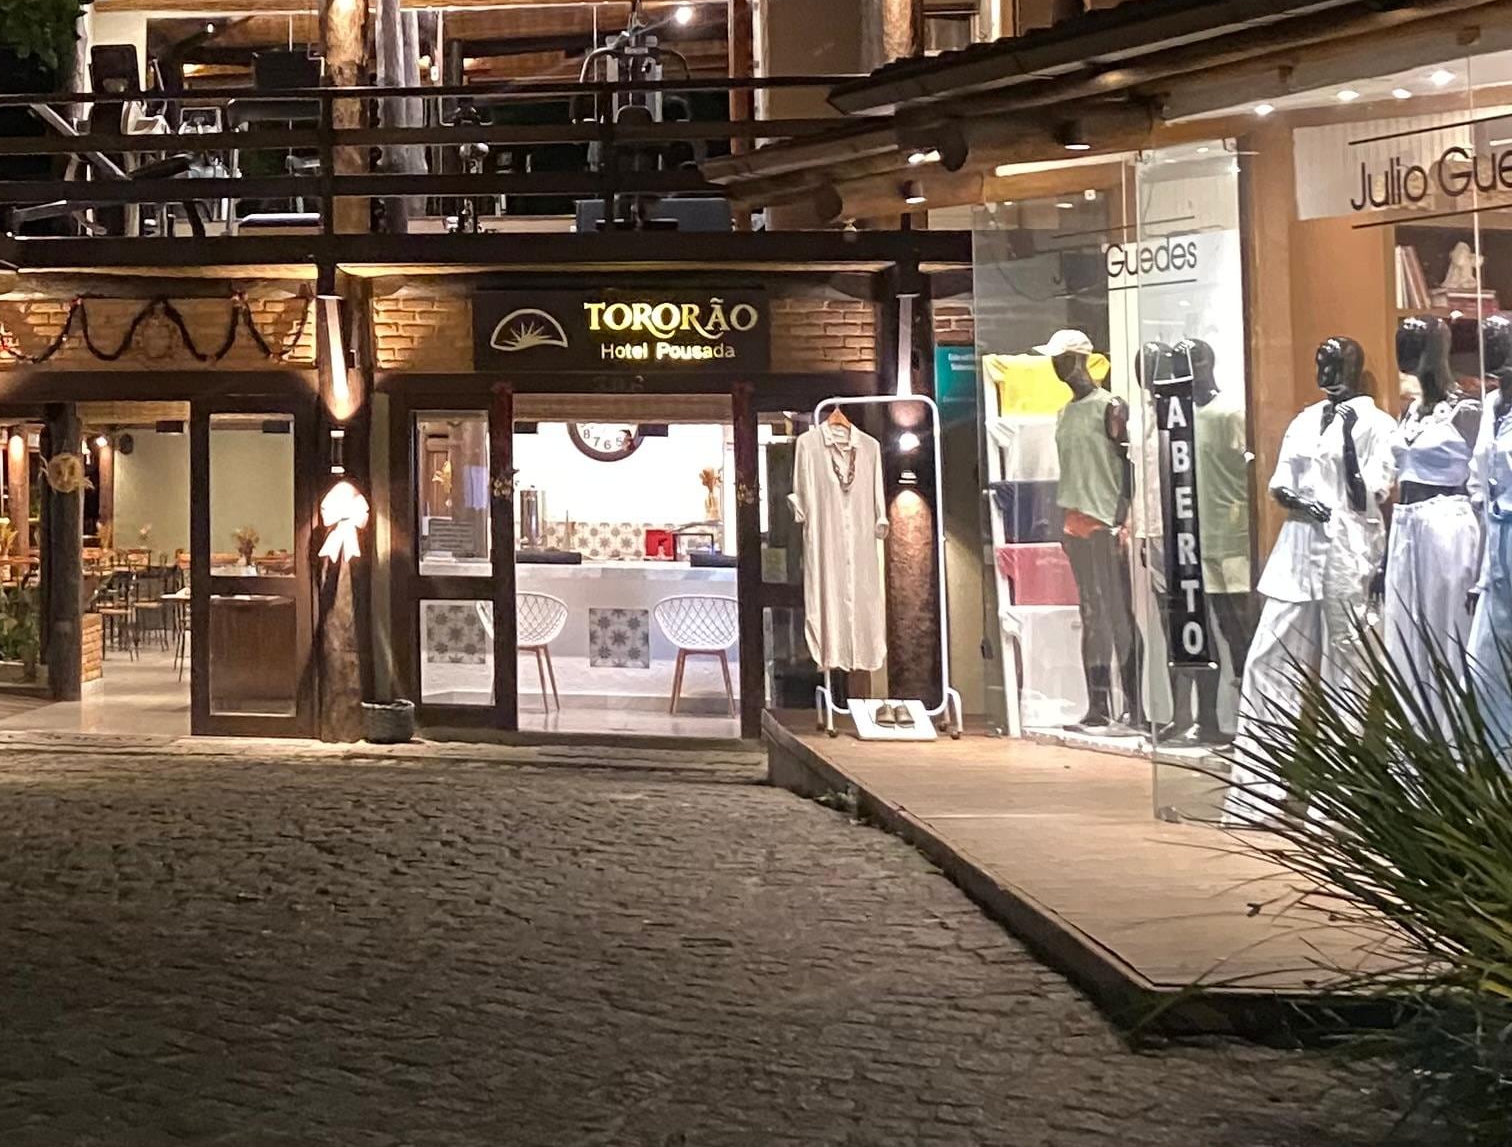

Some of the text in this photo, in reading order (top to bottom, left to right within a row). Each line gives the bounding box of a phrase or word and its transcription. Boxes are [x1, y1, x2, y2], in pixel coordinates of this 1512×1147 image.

[1350, 156, 1428, 211] Julio
[1104, 236, 1198, 278] Guedes
[583, 298, 758, 339] TORORÃO
[600, 342, 736, 360] Hotel Pousada
[583, 428, 591, 439] 8
[593, 436, 601, 447] 7
[603, 440, 612, 450] 6
[1166, 395, 1204, 656] ABERTO
